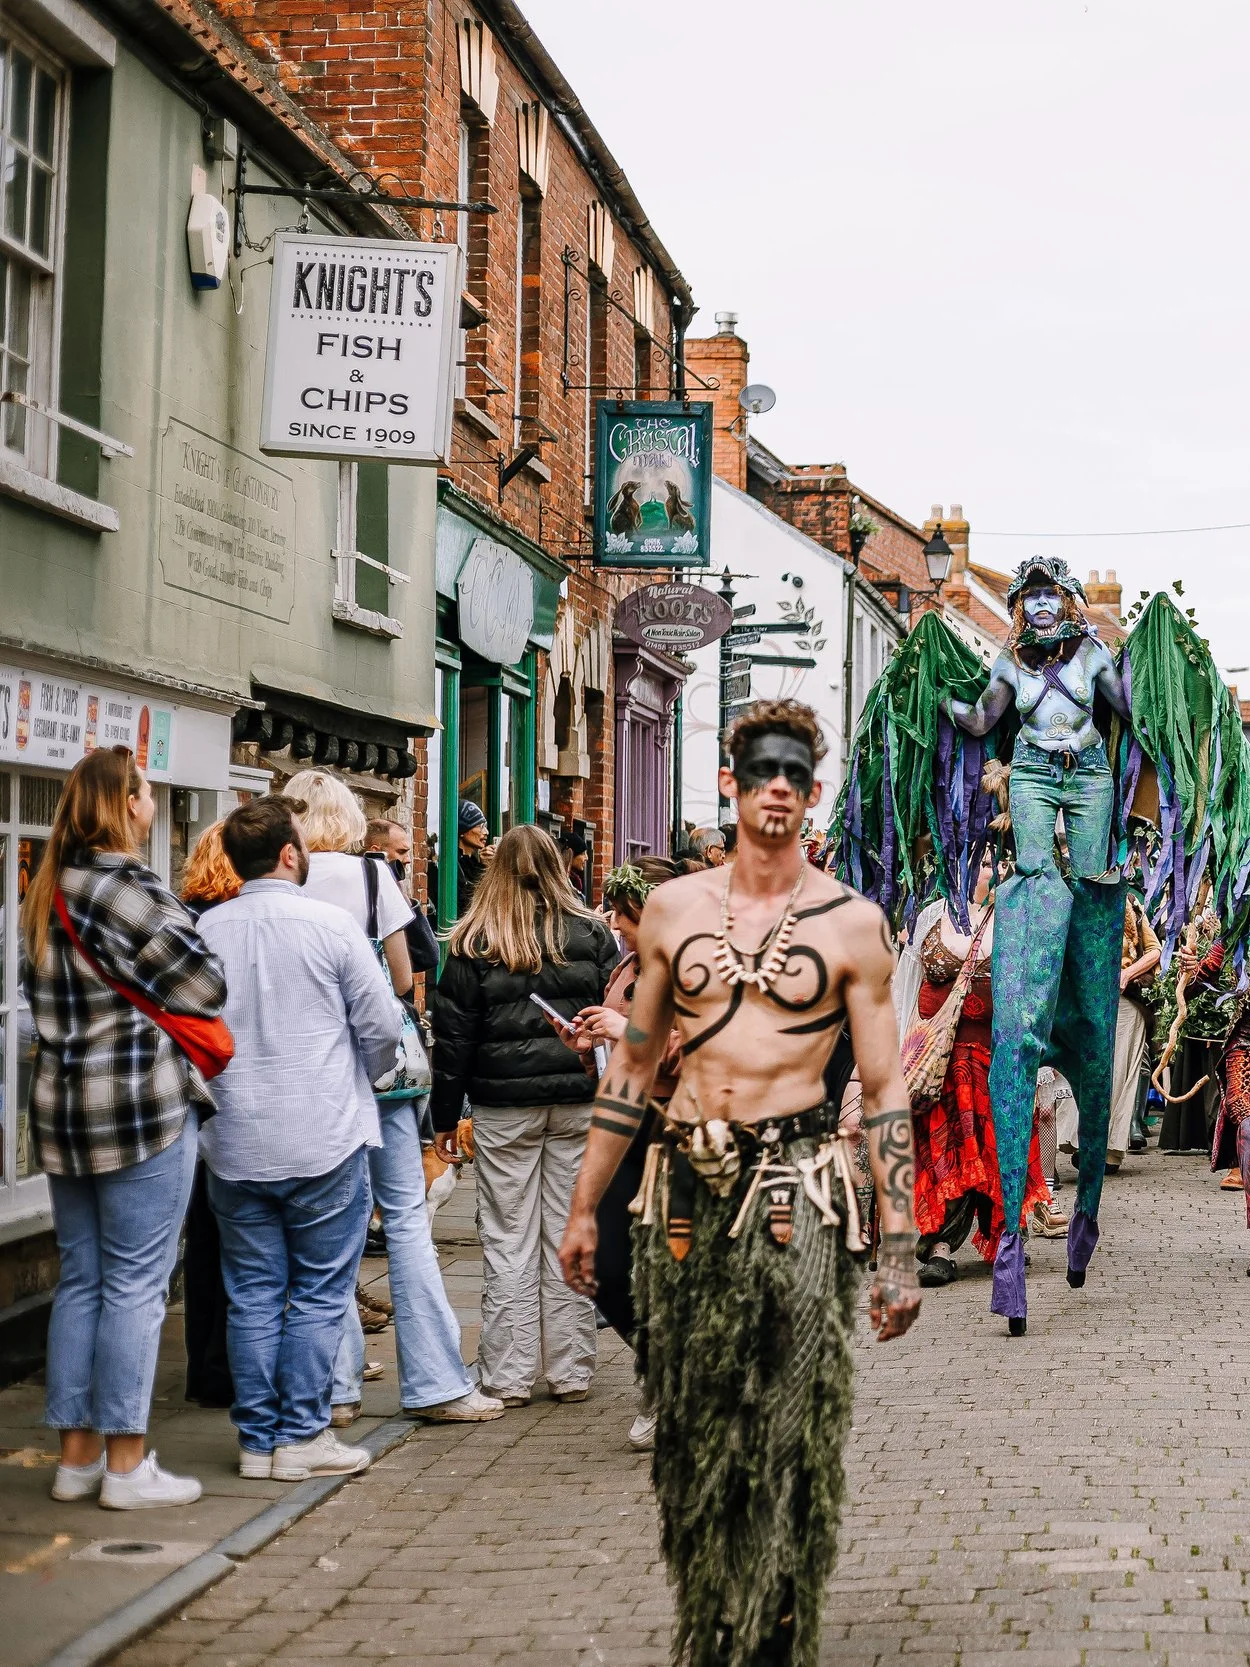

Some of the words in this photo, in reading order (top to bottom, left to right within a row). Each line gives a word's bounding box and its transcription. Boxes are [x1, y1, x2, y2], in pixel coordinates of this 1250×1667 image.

[293, 261, 434, 317] KNIGHT'S
[316, 332, 402, 361] FISH
[349, 369, 364, 383] &
[300, 387, 409, 415] CHIPS
[288, 422, 357, 441] SINCE
[366, 427, 416, 444] 1909
[636, 418, 672, 429] THE
[609, 422, 700, 469] CRYSTAL
[647, 583, 695, 599] Natural
[633, 599, 715, 625] ROOTS
[645, 629, 651, 637] A
[651, 628, 661, 637] Non
[661, 628, 674, 637] Toxic
[674, 628, 685, 637] Hair
[685, 628, 700, 637] Salon
[0, 684, 11, 739] 'S
[40, 682, 54, 712] FISH
[55, 686, 60, 712] &
[61, 687, 79, 717] CHIPS
